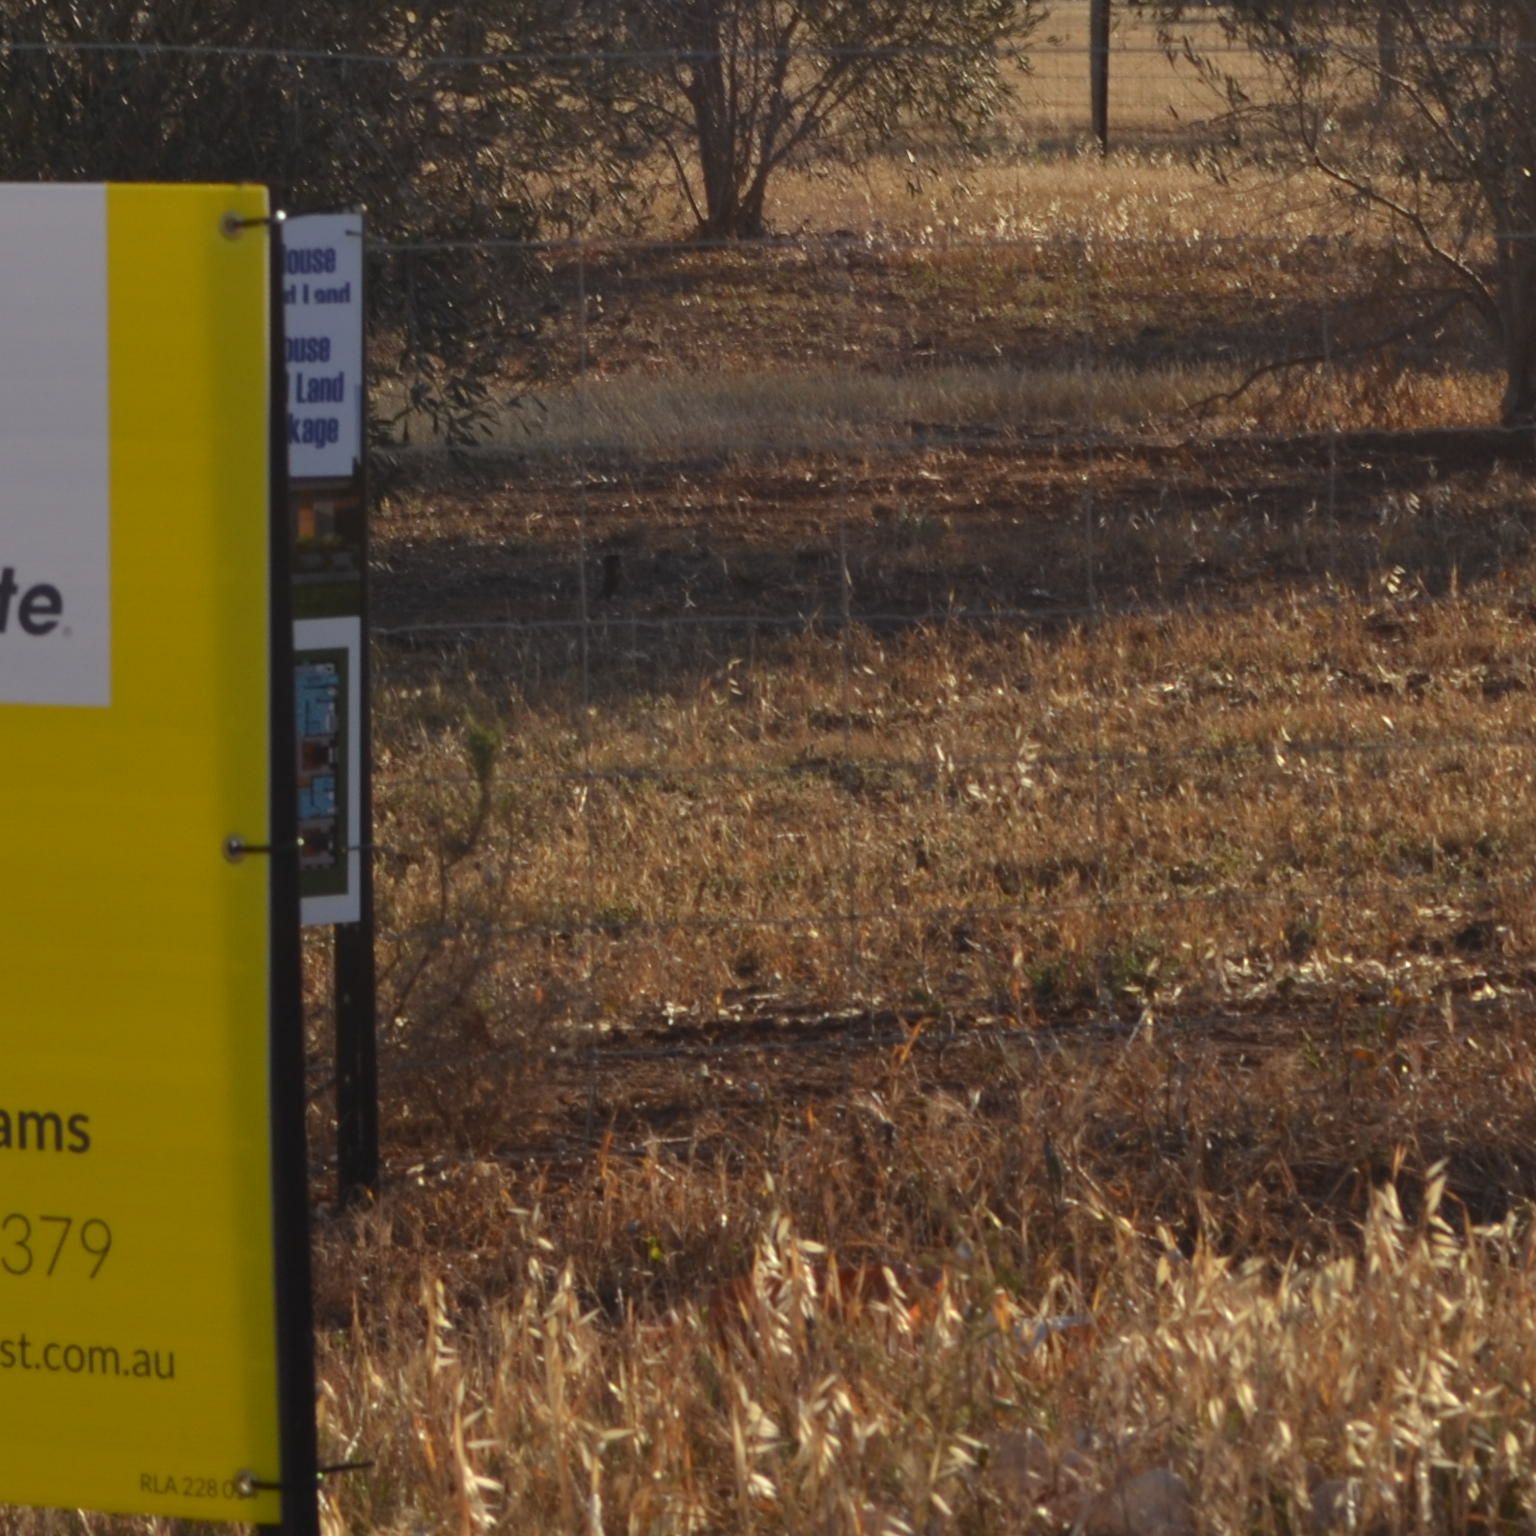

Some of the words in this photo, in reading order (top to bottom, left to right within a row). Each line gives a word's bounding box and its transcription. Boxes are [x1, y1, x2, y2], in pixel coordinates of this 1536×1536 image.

[295, 371, 345, 404] Land
[0, 1212, 113, 1280] 379
[139, 1473, 179, 1495] RLA
[182, 1476, 219, 1499] 228
